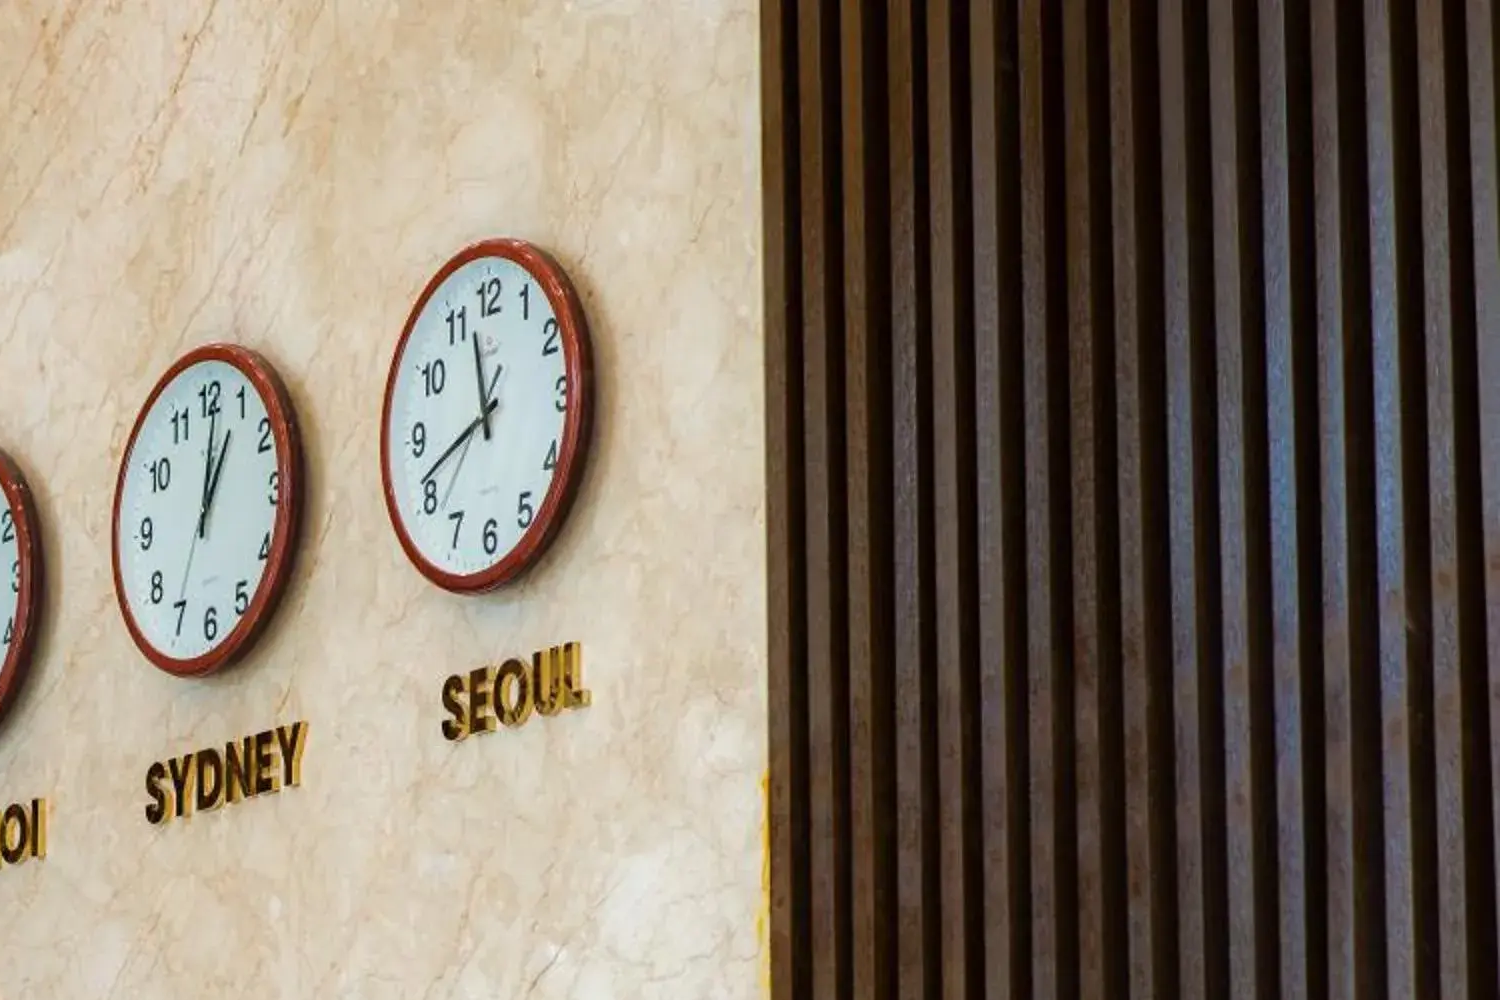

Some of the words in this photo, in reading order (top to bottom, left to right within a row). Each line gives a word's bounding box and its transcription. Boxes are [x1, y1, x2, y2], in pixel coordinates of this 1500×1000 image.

[476, 278, 501, 317] 12
[519, 284, 530, 320] 1
[446, 306, 467, 345] 11
[542, 318, 558, 356] 2
[421, 359, 445, 397] 10
[555, 376, 567, 412] 3
[198, 381, 221, 418] 12
[236, 385, 245, 419] 1
[171, 407, 190, 444] 11
[258, 418, 272, 454] 2
[412, 421, 426, 458] 9
[543, 439, 557, 471] 4
[150, 457, 171, 493] 10
[424, 479, 437, 515] 8
[517, 492, 532, 528] 5
[1, 509, 14, 543] 2
[140, 517, 153, 550] 9
[449, 511, 465, 549] 7
[482, 518, 498, 554] 6
[258, 531, 270, 560] 4
[151, 570, 163, 604] 8
[235, 580, 249, 615] 5
[173, 600, 187, 636] 7
[204, 606, 217, 641] 6
[441, 641, 592, 741] SEOUL
[145, 720, 310, 824] SYDNEY
